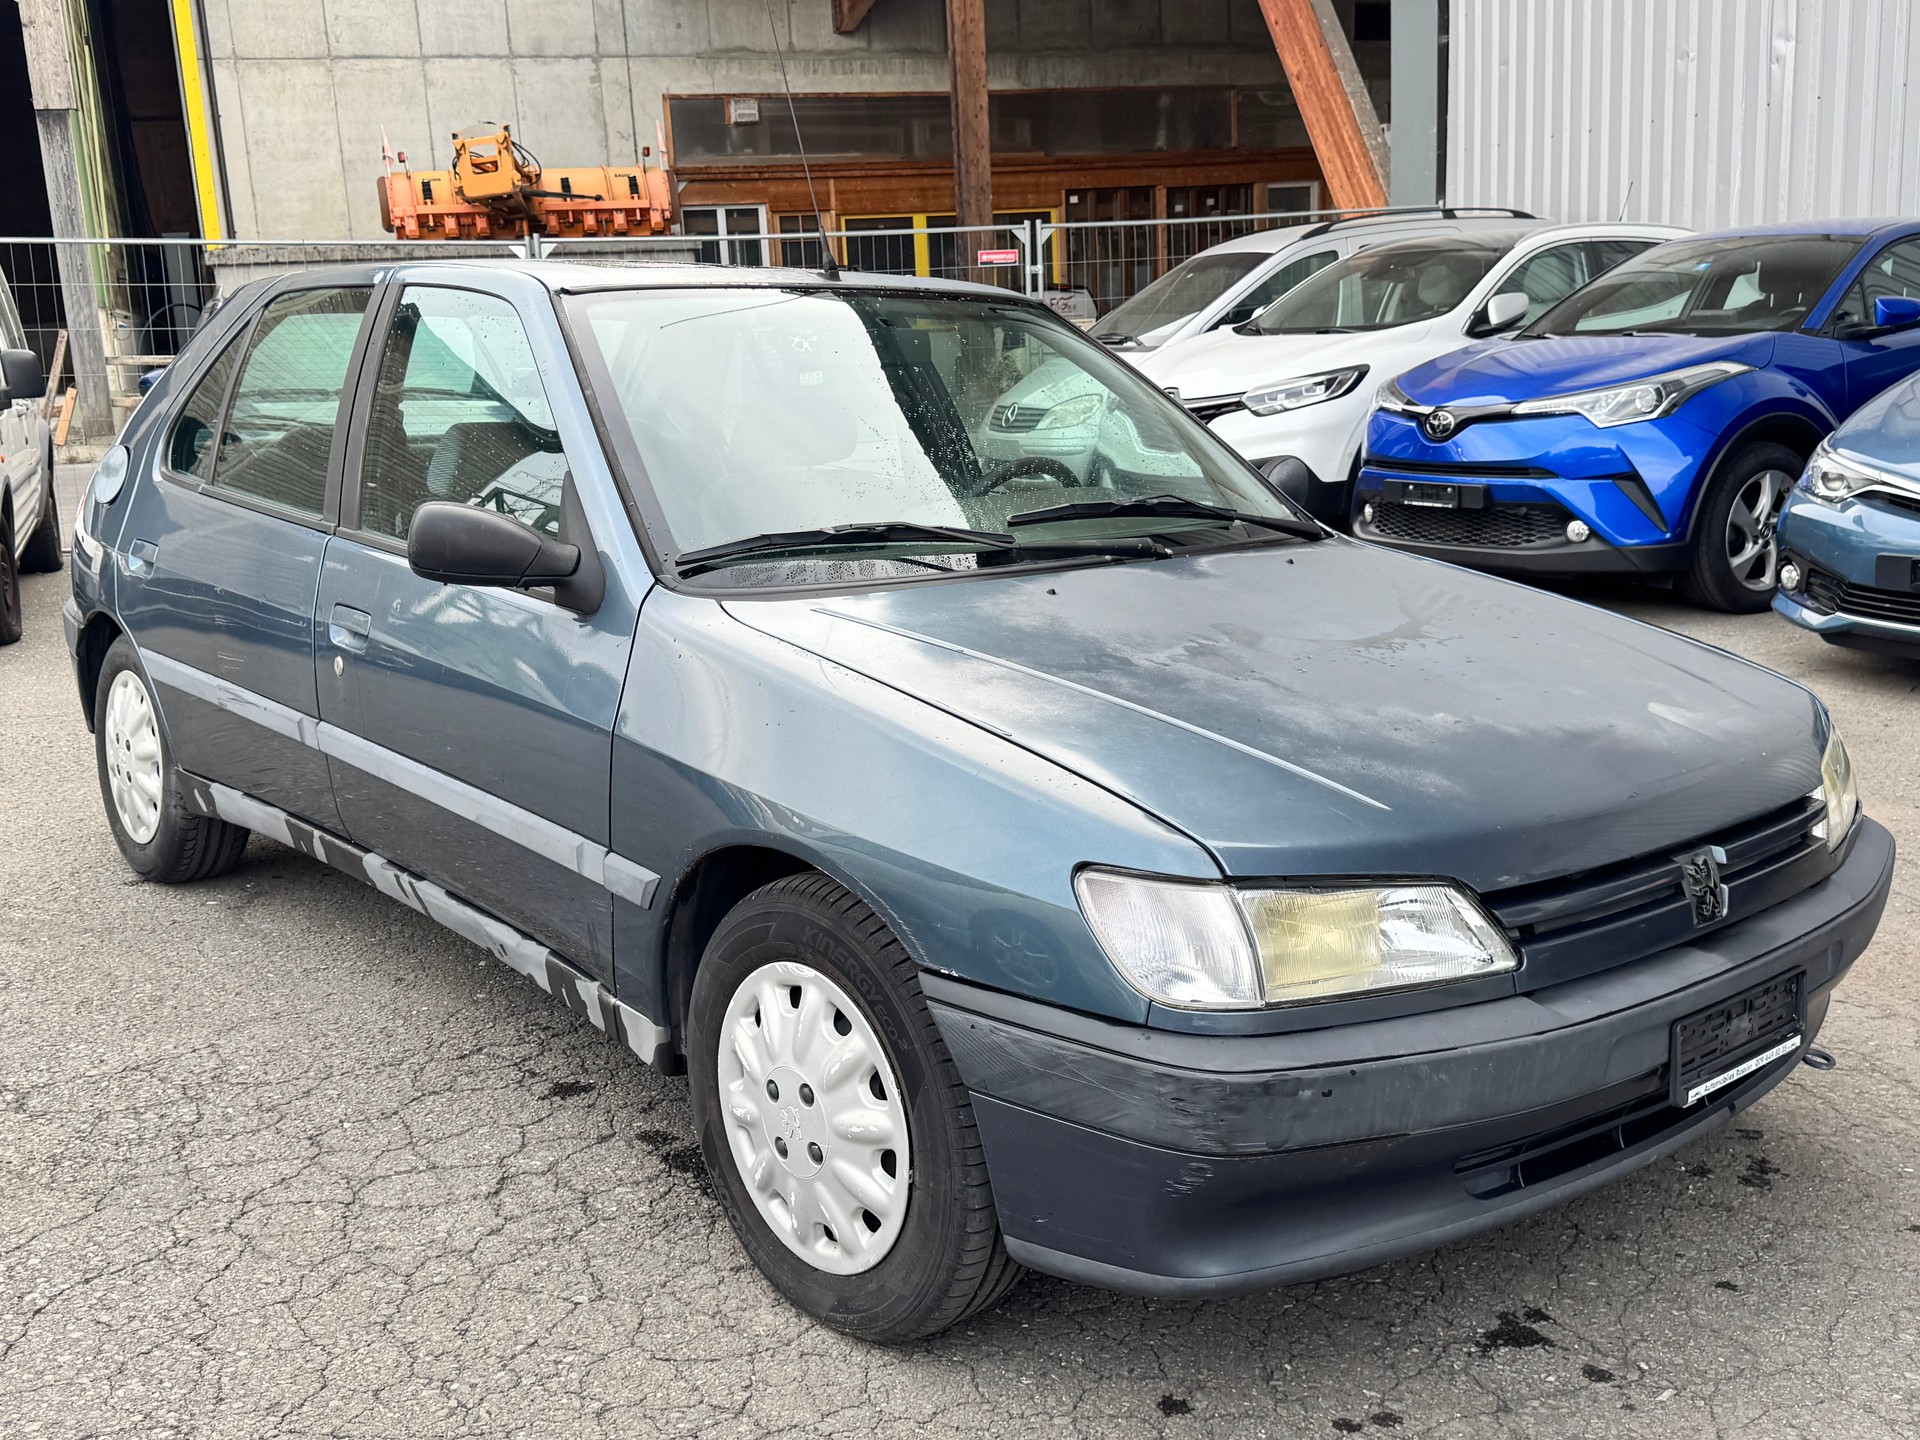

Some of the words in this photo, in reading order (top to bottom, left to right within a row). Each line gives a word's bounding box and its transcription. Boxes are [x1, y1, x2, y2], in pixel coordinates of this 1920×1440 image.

[801, 925, 884, 1001] KINERGY
[1704, 1072, 1735, 1092] Automobiles
[1755, 1056, 1764, 1067] 079
